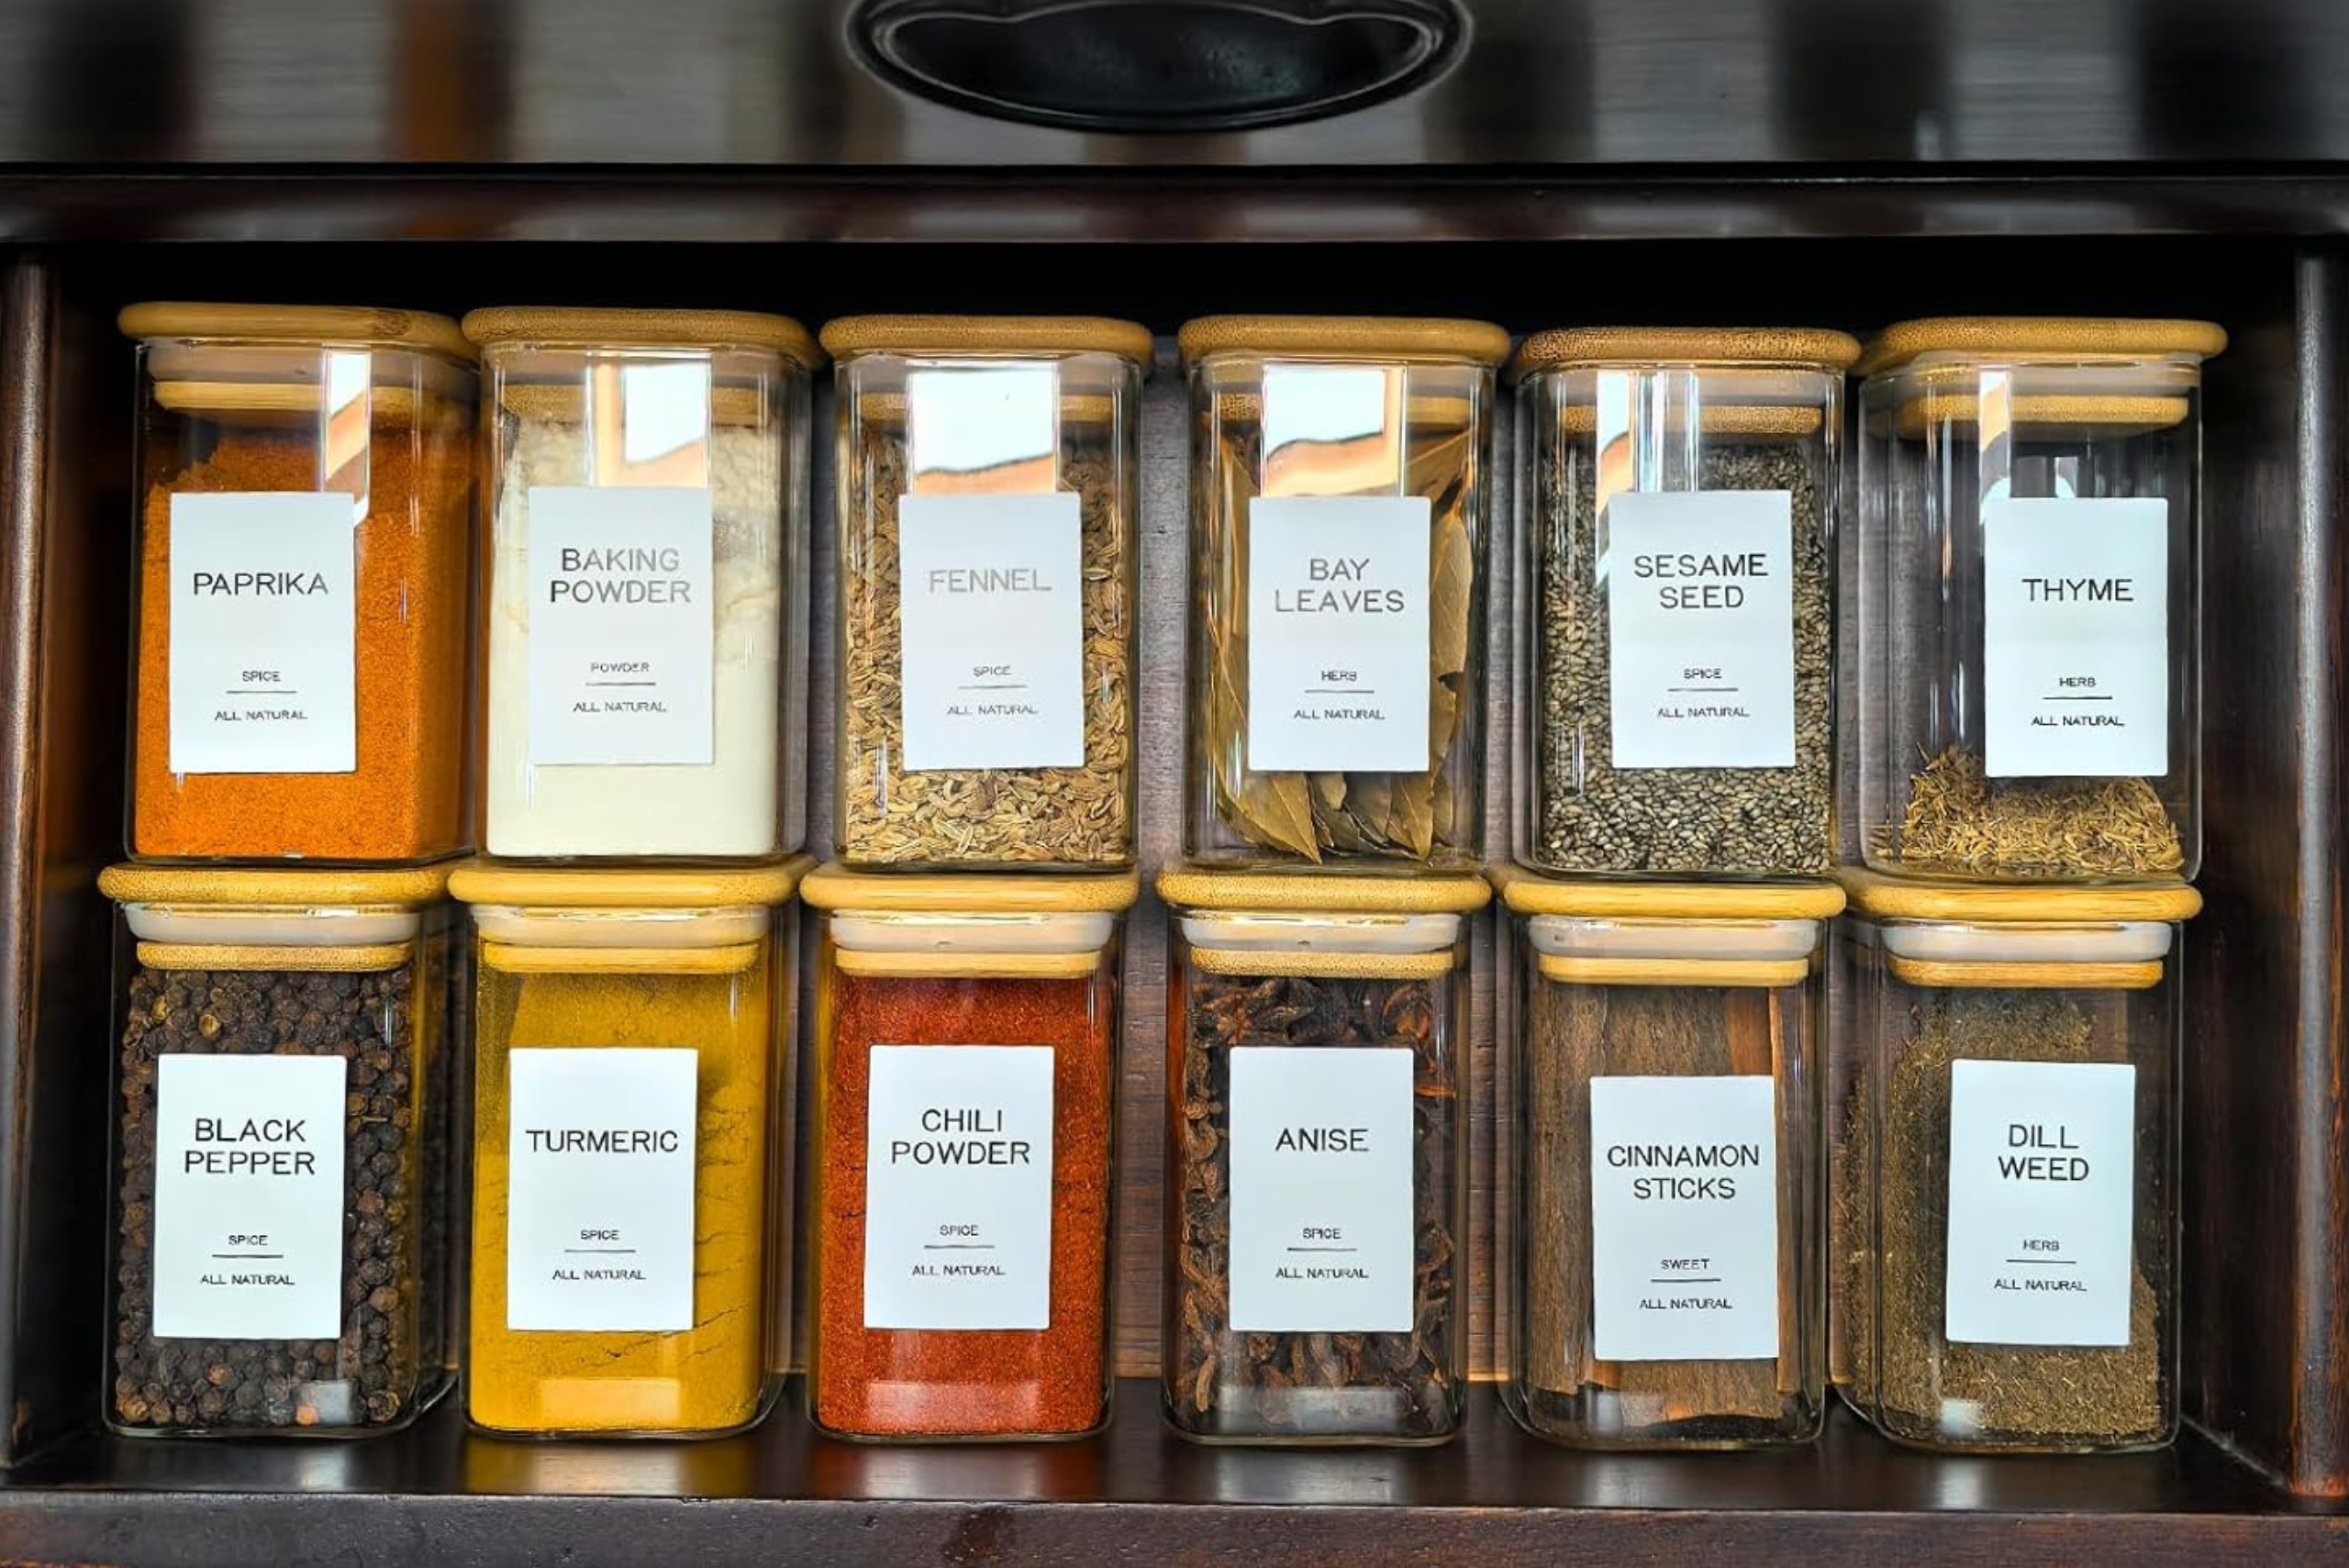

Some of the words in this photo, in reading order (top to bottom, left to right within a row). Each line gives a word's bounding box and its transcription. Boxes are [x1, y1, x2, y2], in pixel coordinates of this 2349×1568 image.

[561, 547, 680, 573] BAKING
[1633, 552, 1770, 579] SESAME
[1308, 557, 1371, 583] BAY
[193, 571, 329, 596] PAPRIKA
[929, 568, 1052, 594] FENNEL
[549, 579, 692, 605] POWDER
[1659, 584, 1744, 610] SEED
[2020, 577, 2135, 603] THYME
[1275, 588, 1405, 614] LEAVES
[590, 661, 651, 674] POWDER
[972, 664, 1012, 678] SPICE
[1683, 667, 1723, 681] SPICE
[241, 670, 283, 683] SPICE
[1320, 669, 1358, 683] HERB
[2058, 675, 2098, 689] HERB
[572, 700, 601, 714] ALL
[605, 700, 668, 714] NATURAL
[946, 704, 974, 717] ALL
[978, 704, 1039, 717] NATURAL
[1656, 706, 1685, 719] ALL
[1687, 706, 1751, 719] NATURAL
[213, 708, 242, 722] ALL
[245, 708, 309, 722] NATURAL
[1293, 708, 1321, 721] ALL
[1323, 708, 1386, 721] NATURAL
[2030, 714, 2059, 728] ALL
[2062, 714, 2126, 728] NATURAL
[921, 1107, 1003, 1133] CHILI
[195, 1117, 307, 1144] BLACK
[2007, 1122, 2080, 1151] DILL
[524, 1129, 679, 1154] TURMERIC
[1274, 1127, 1371, 1153] ANISE
[890, 1140, 1031, 1166] POWDER
[1606, 1143, 1760, 1168] CINNAMON
[184, 1149, 316, 1176] PEPPER
[1997, 1154, 2090, 1182] WEED
[1632, 1176, 1737, 1201] STICKS
[580, 1229, 620, 1241] SPICE
[939, 1223, 980, 1237] SPICE
[1302, 1227, 1342, 1240] SPICE
[228, 1234, 269, 1247] SPICE
[2021, 1239, 2061, 1252] HERB
[911, 1263, 939, 1277] ALL
[942, 1263, 1007, 1277] NATURAL
[1660, 1257, 1711, 1271] SWEET
[198, 1273, 228, 1287] ALL
[230, 1273, 296, 1287] NATURAL
[551, 1268, 581, 1281] ALL
[584, 1268, 648, 1281] NATURAL
[1275, 1266, 1304, 1280] ALL
[1307, 1266, 1370, 1280] NATURAL
[1992, 1277, 2022, 1293] ALL
[2024, 1277, 2088, 1293] NATURAL
[1638, 1297, 1668, 1310] ALL
[1669, 1297, 1734, 1310] NATURAL
